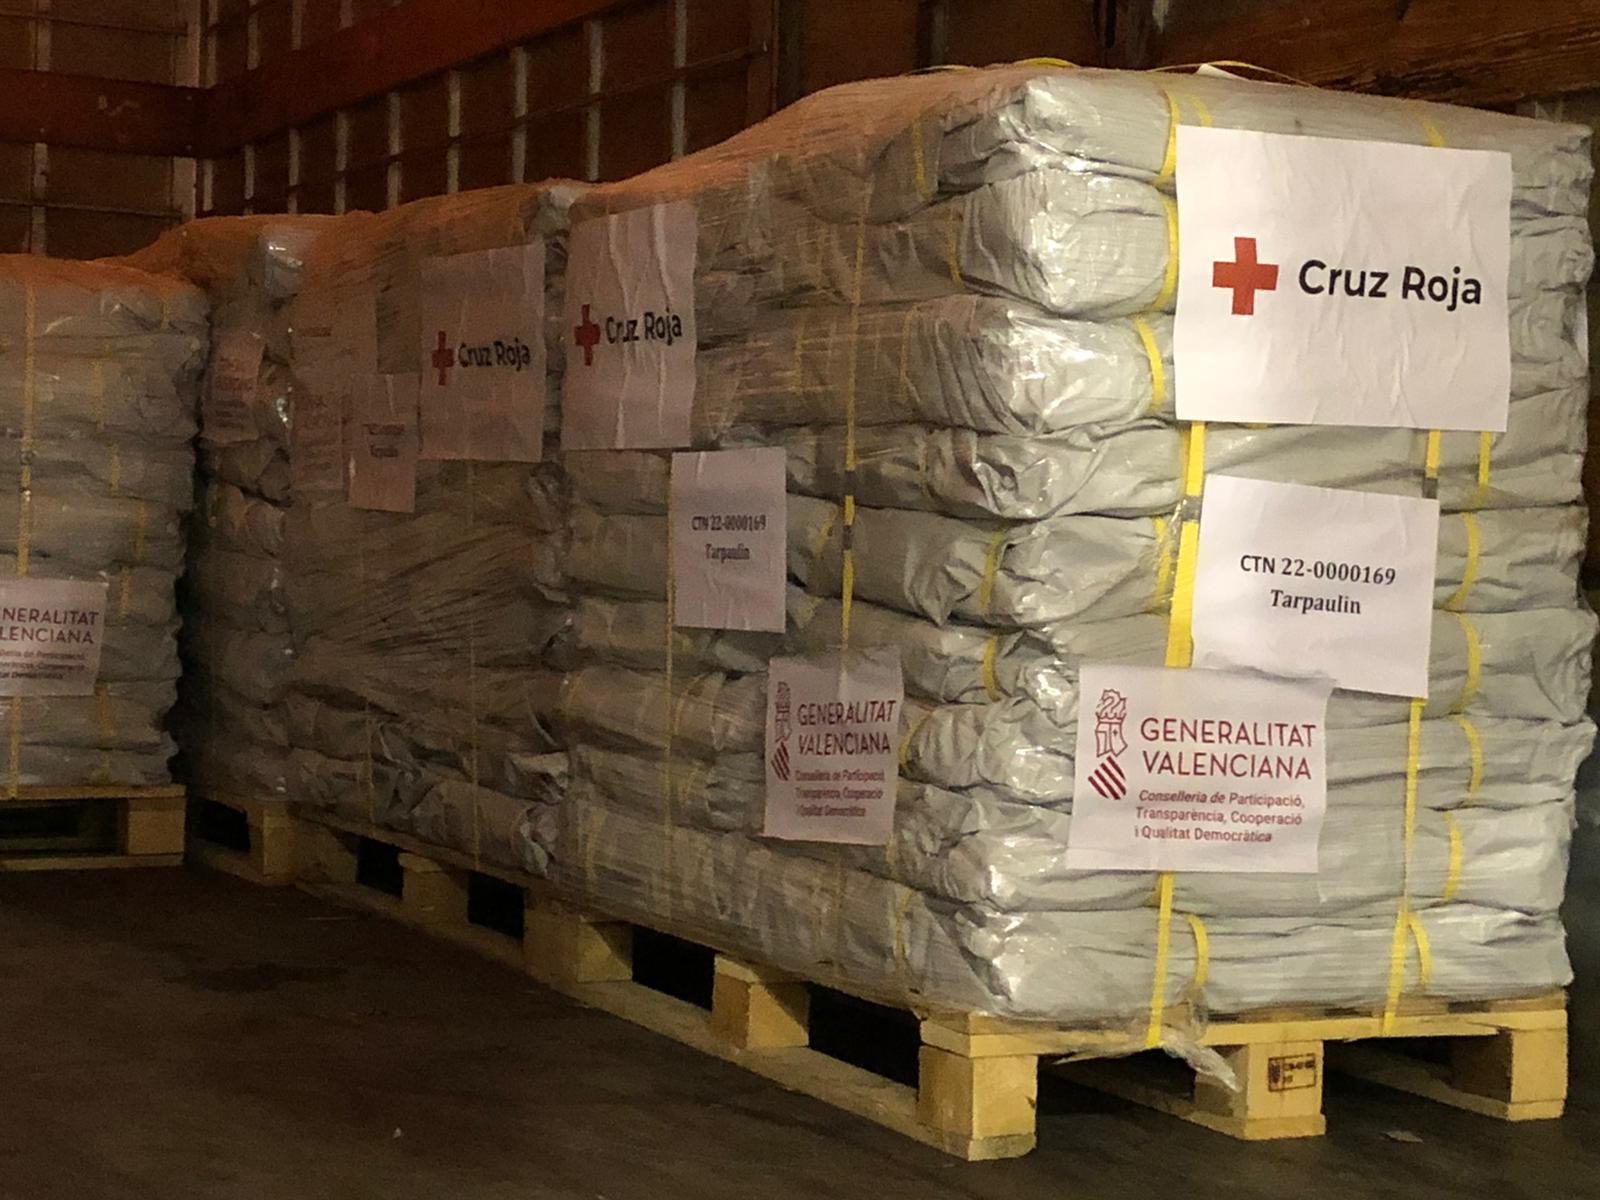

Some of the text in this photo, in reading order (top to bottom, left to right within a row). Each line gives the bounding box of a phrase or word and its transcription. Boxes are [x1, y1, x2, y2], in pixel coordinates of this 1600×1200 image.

[1298, 259, 1482, 312] Cruz Roja
[605, 307, 682, 346] Cruz Roja
[457, 337, 530, 372] Cruz Roja
[1240, 554, 1396, 586] CTN 22-0000169
[1270, 588, 1361, 615] Tarpaulin
[798, 700, 896, 726] GENERALITAT
[798, 731, 891, 756] VALENCIANA
[1140, 717, 1316, 747] GENERALITAT
[1142, 750, 1312, 780] VALENCIANA
[1138, 789, 1306, 809] Conselleria de Participació,
[1136, 806, 1303, 827] Transparència, Cooperació
[1134, 825, 1273, 843] i Qualitat Democràtica
